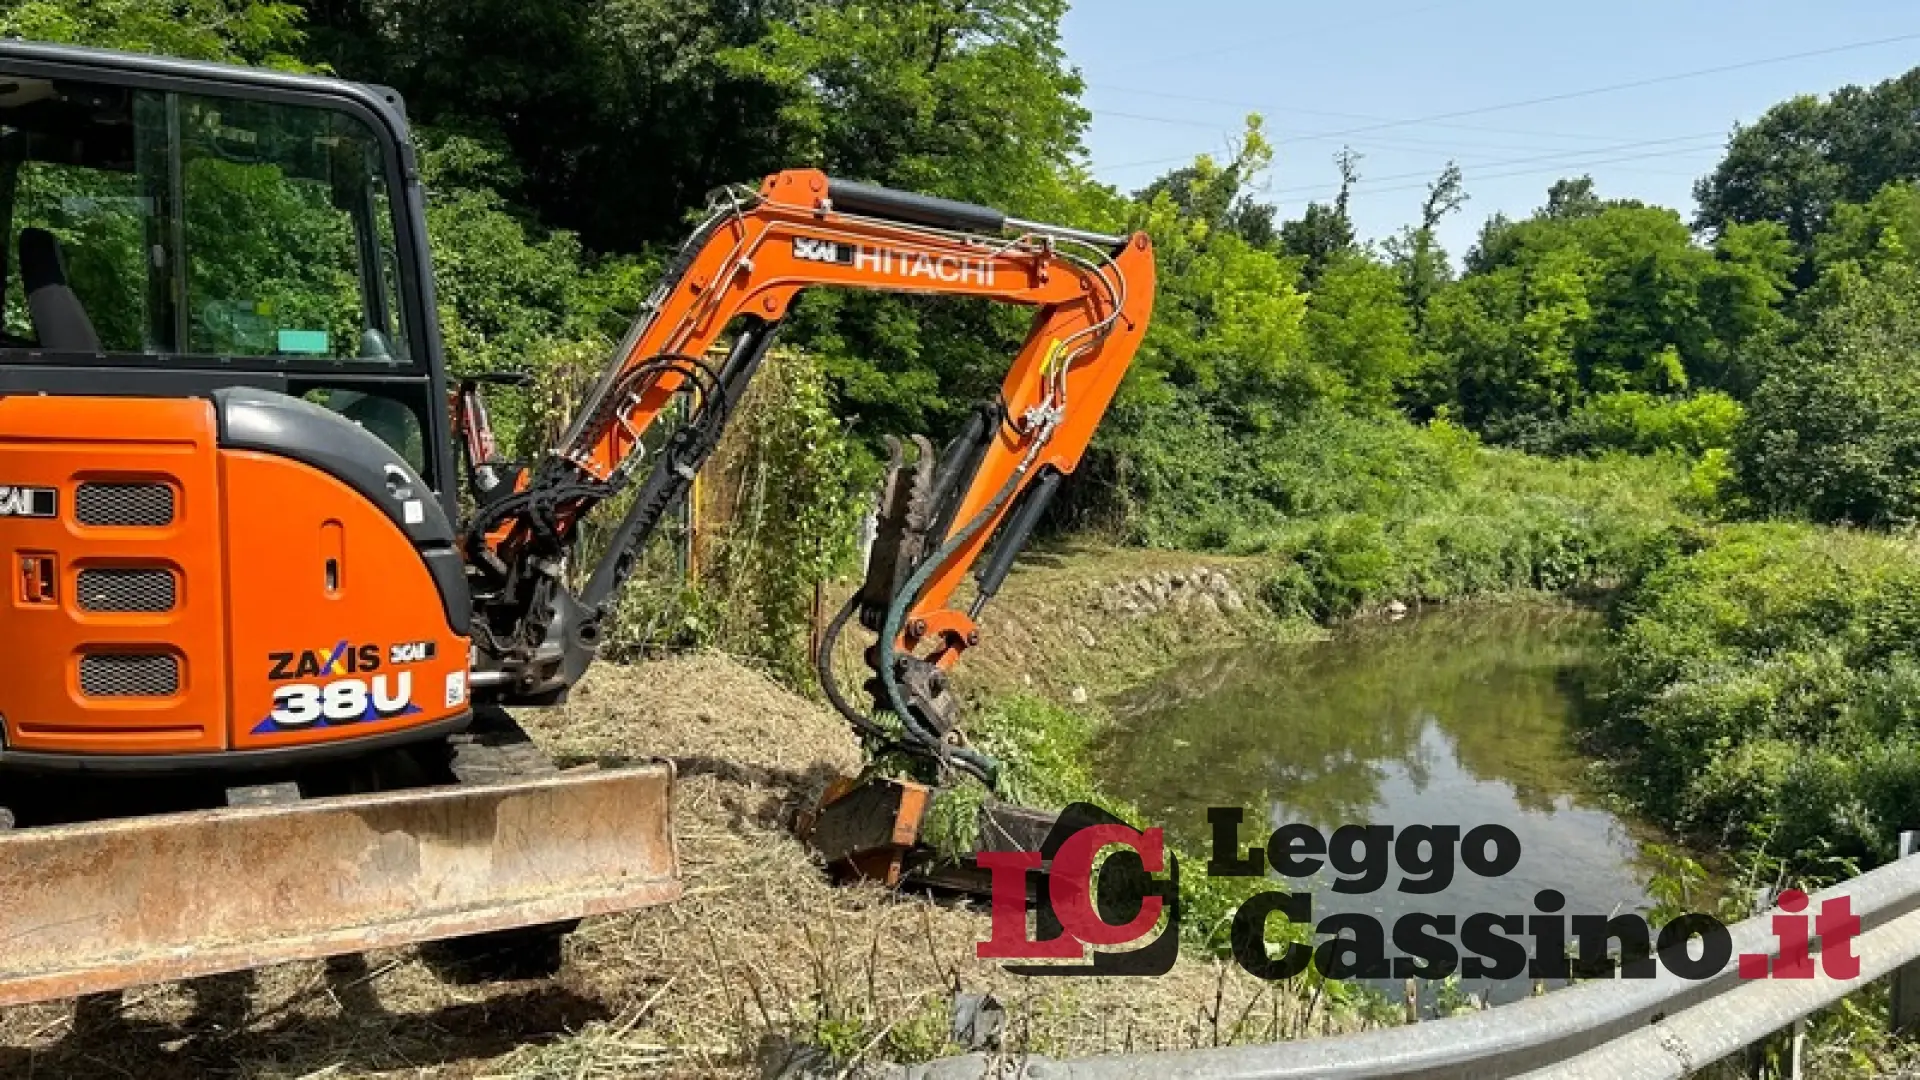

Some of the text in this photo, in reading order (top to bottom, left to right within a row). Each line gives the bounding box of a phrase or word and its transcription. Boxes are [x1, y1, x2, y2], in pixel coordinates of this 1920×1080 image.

[854, 244, 995, 287] HITACHI
[268, 640, 380, 680] ZAXIS
[270, 671, 412, 724] 38U
